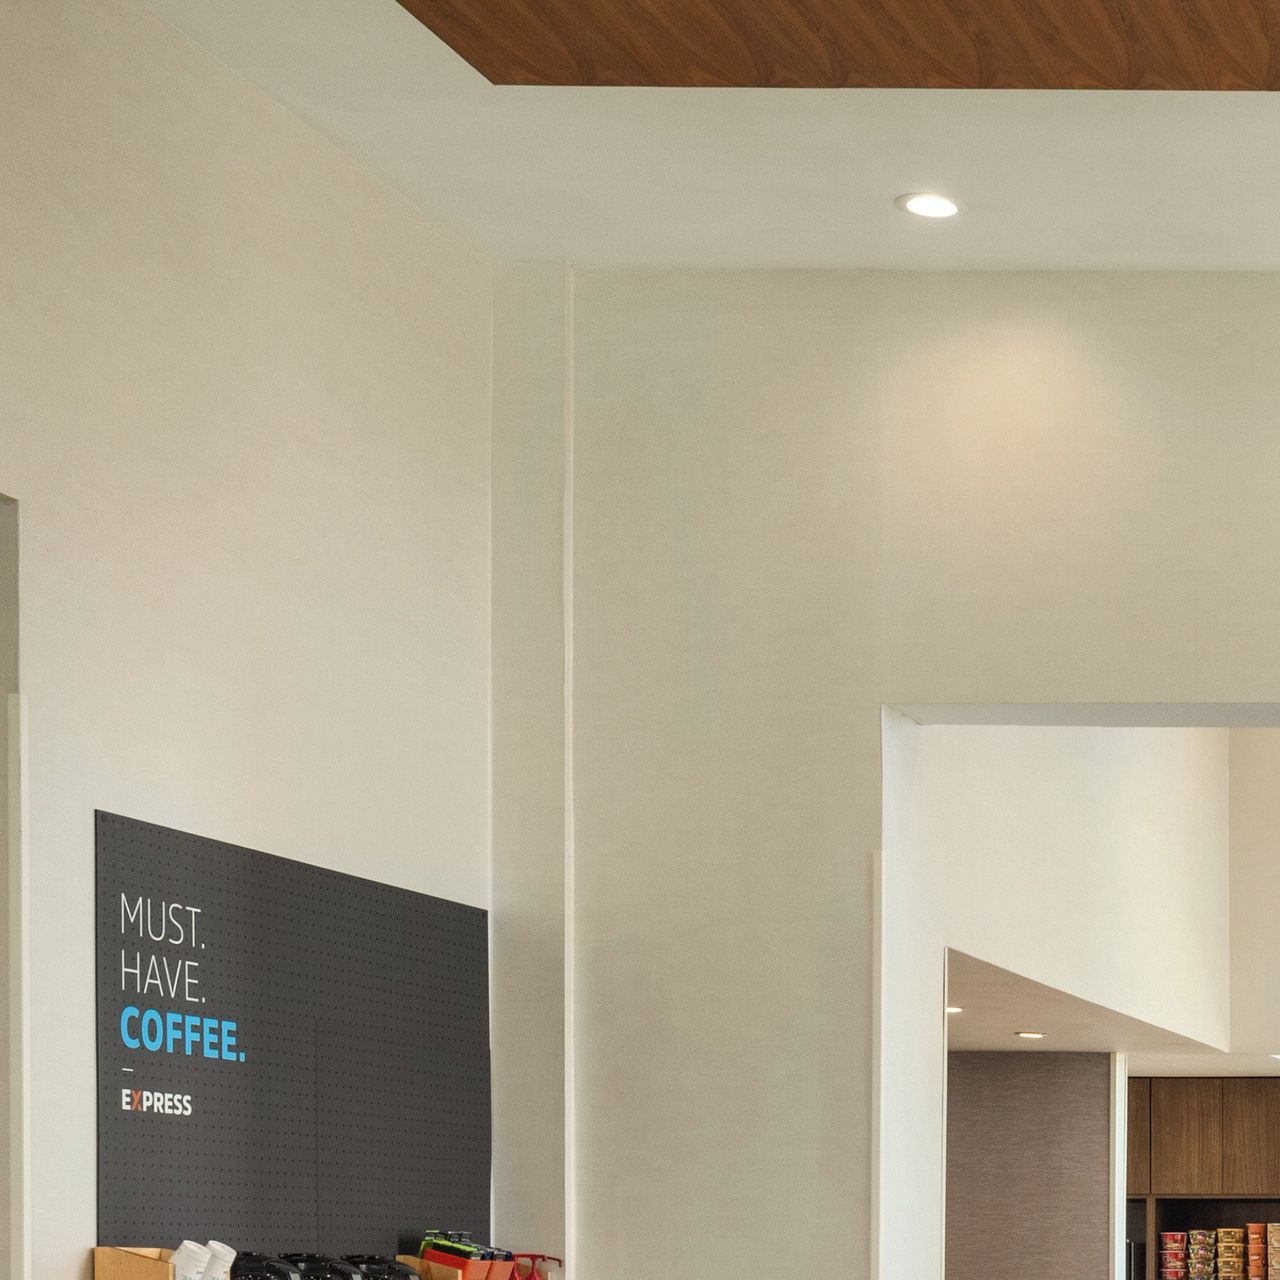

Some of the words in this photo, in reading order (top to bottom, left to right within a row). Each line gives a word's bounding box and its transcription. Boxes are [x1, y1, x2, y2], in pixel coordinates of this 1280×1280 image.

[121, 892, 206, 950] MUST.
[121, 949, 206, 1004] HAVE.
[120, 1006, 246, 1063] COFFEE.
[120, 1087, 193, 1117] EXPRESS
